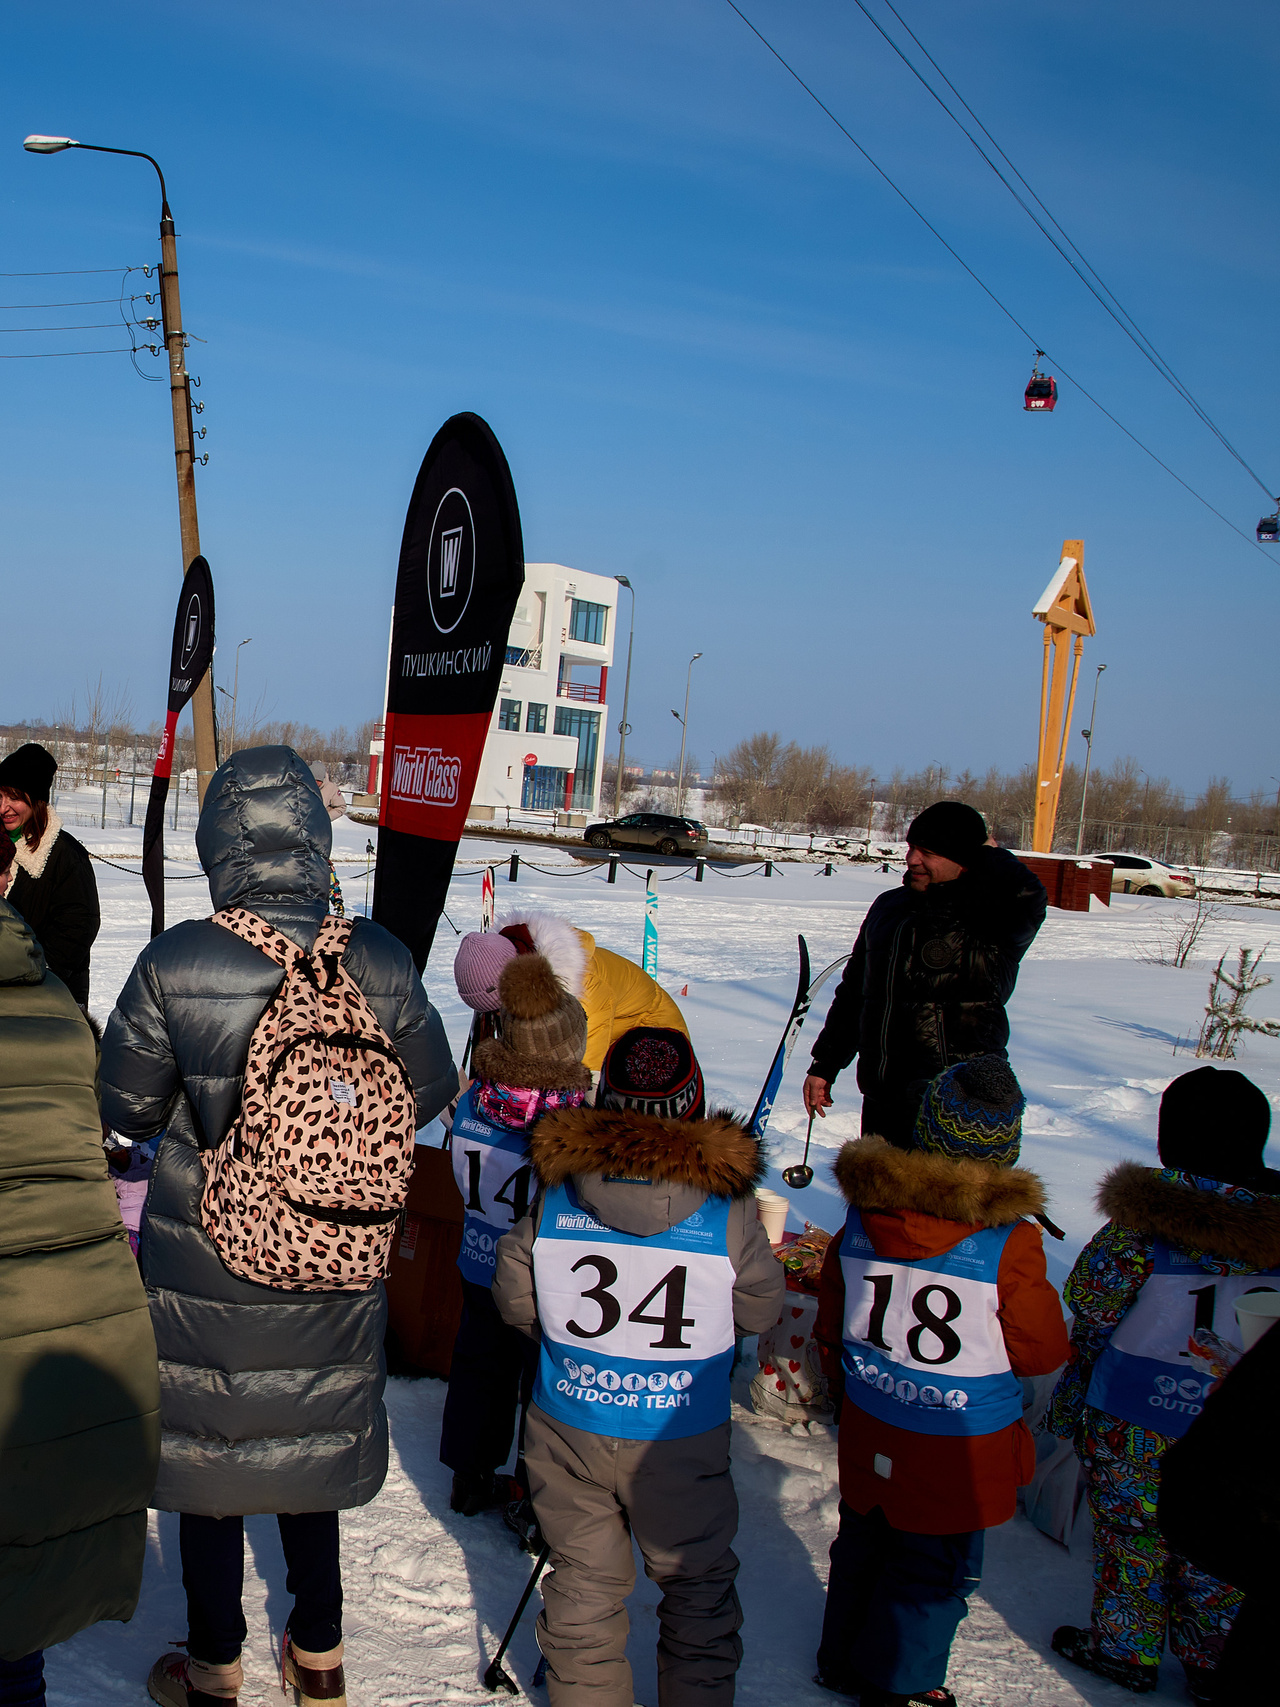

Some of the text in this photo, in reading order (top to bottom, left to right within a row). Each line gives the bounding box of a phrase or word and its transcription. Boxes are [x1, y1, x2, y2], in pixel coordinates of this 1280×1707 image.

[401, 640, 492, 677] ПУШКИНСКИЙ
[392, 751, 458, 800] World Class
[647, 934, 658, 981] DWAY
[461, 1118, 492, 1136] World Class
[464, 1150, 531, 1224] 14
[558, 1215, 585, 1229] World
[565, 1254, 696, 1349] 34
[861, 1274, 962, 1366] 18
[555, 1378, 691, 1409] OUTDOOR TEAM
[1148, 1395, 1204, 1416] OUTD
